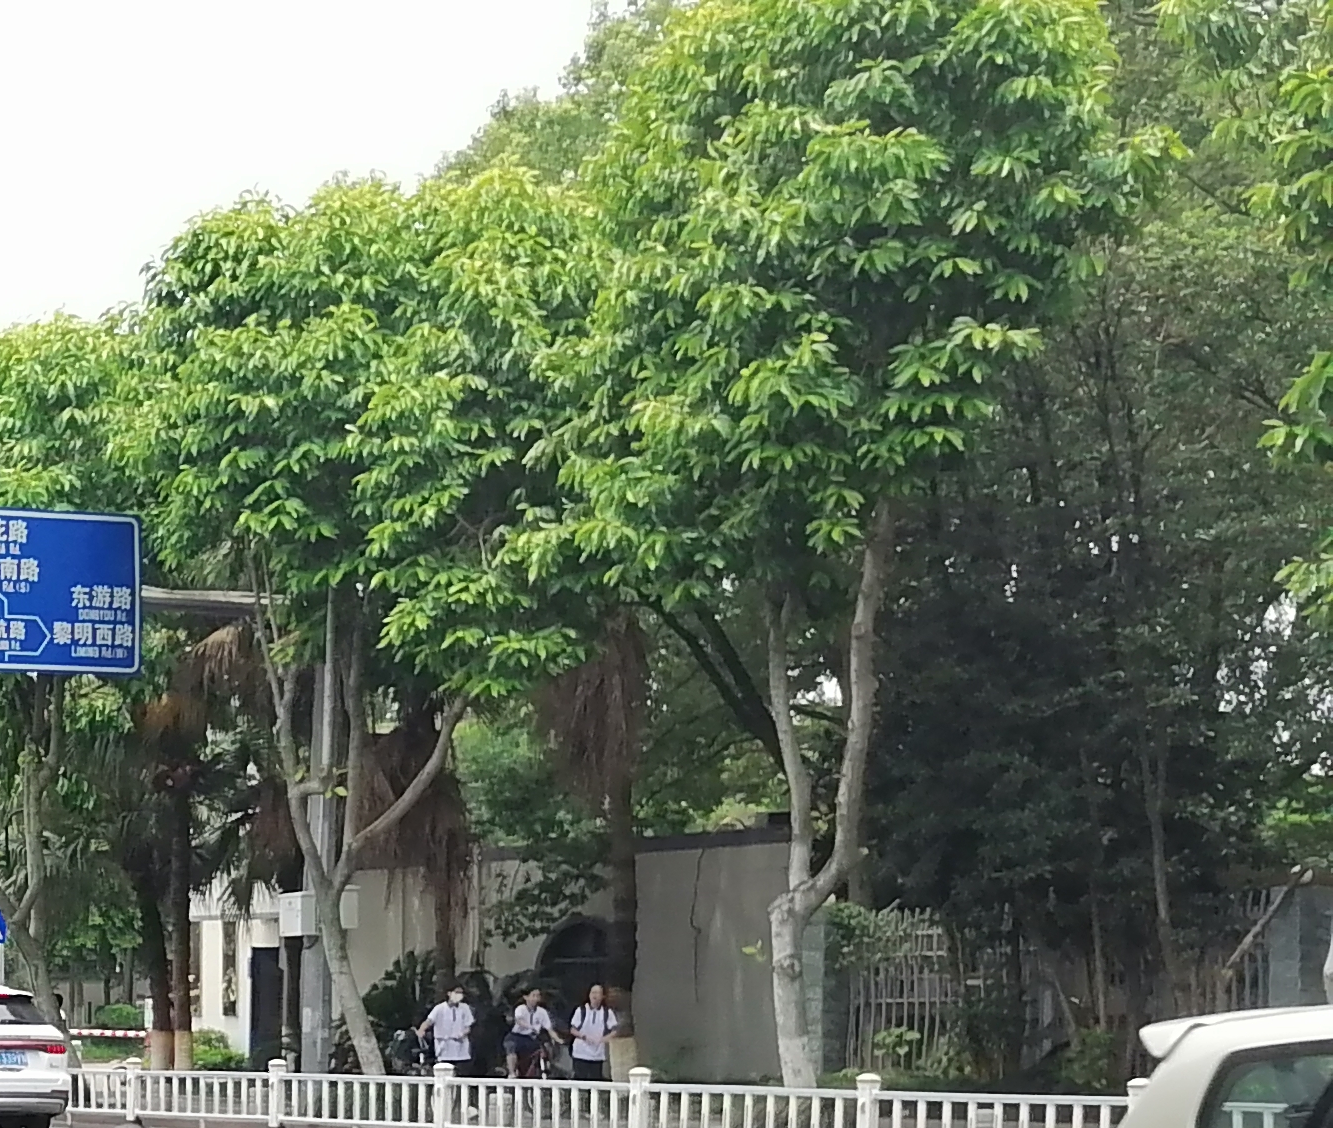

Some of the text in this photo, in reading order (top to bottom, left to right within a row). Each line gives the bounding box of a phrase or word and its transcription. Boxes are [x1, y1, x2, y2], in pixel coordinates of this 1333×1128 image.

[70, 584, 132, 610] 东游路
[53, 621, 133, 647] 黎明西路
